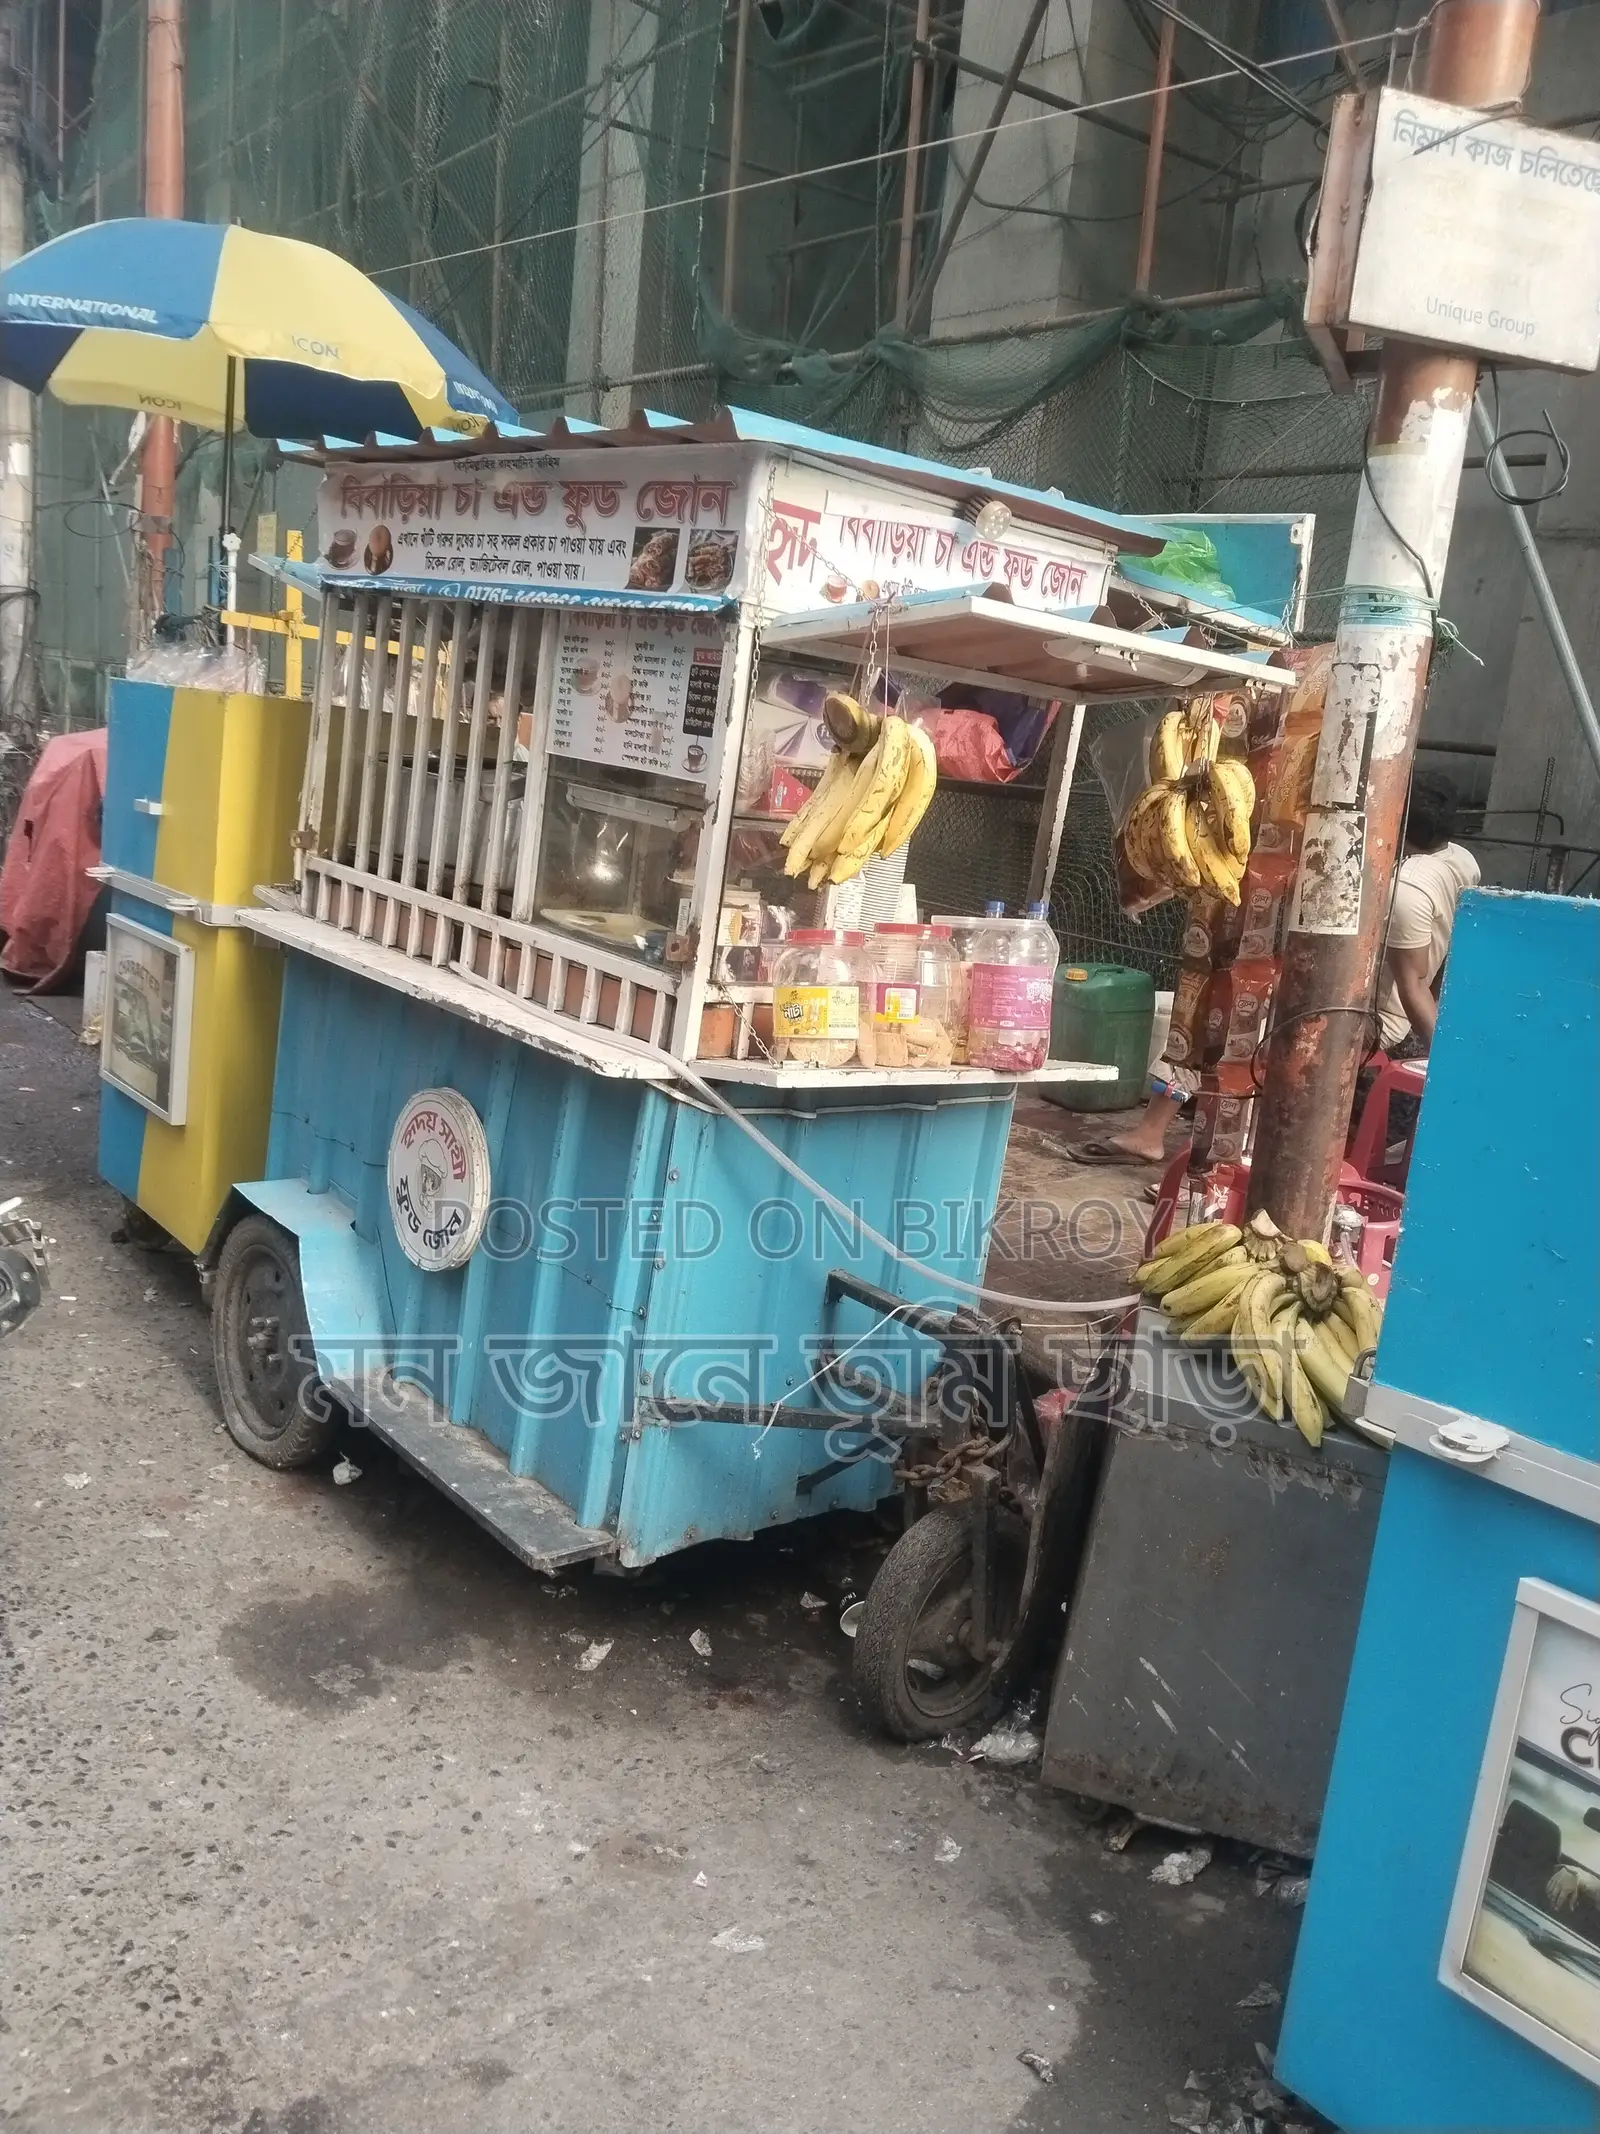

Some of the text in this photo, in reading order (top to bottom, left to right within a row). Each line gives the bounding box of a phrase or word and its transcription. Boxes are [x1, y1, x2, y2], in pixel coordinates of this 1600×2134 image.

[1464, 135, 1514, 171] কাজ
[8, 293, 158, 325] INTERNATIONAL
[1426, 296, 1536, 341] Unique Group
[291, 335, 340, 360] ICON
[452, 478, 486, 520] চা
[558, 480, 628, 535] ফুড
[636, 472, 738, 527] জোন
[476, 533, 486, 550] চা
[500, 534, 522, 551] সকল
[548, 534, 558, 554] চা
[607, 540, 628, 559] এবং
[935, 530, 959, 575] চা
[1041, 559, 1088, 606] জোন
[401, 1110, 439, 1149] হৃদয়
[396, 1174, 463, 1250] ফুড জোন
